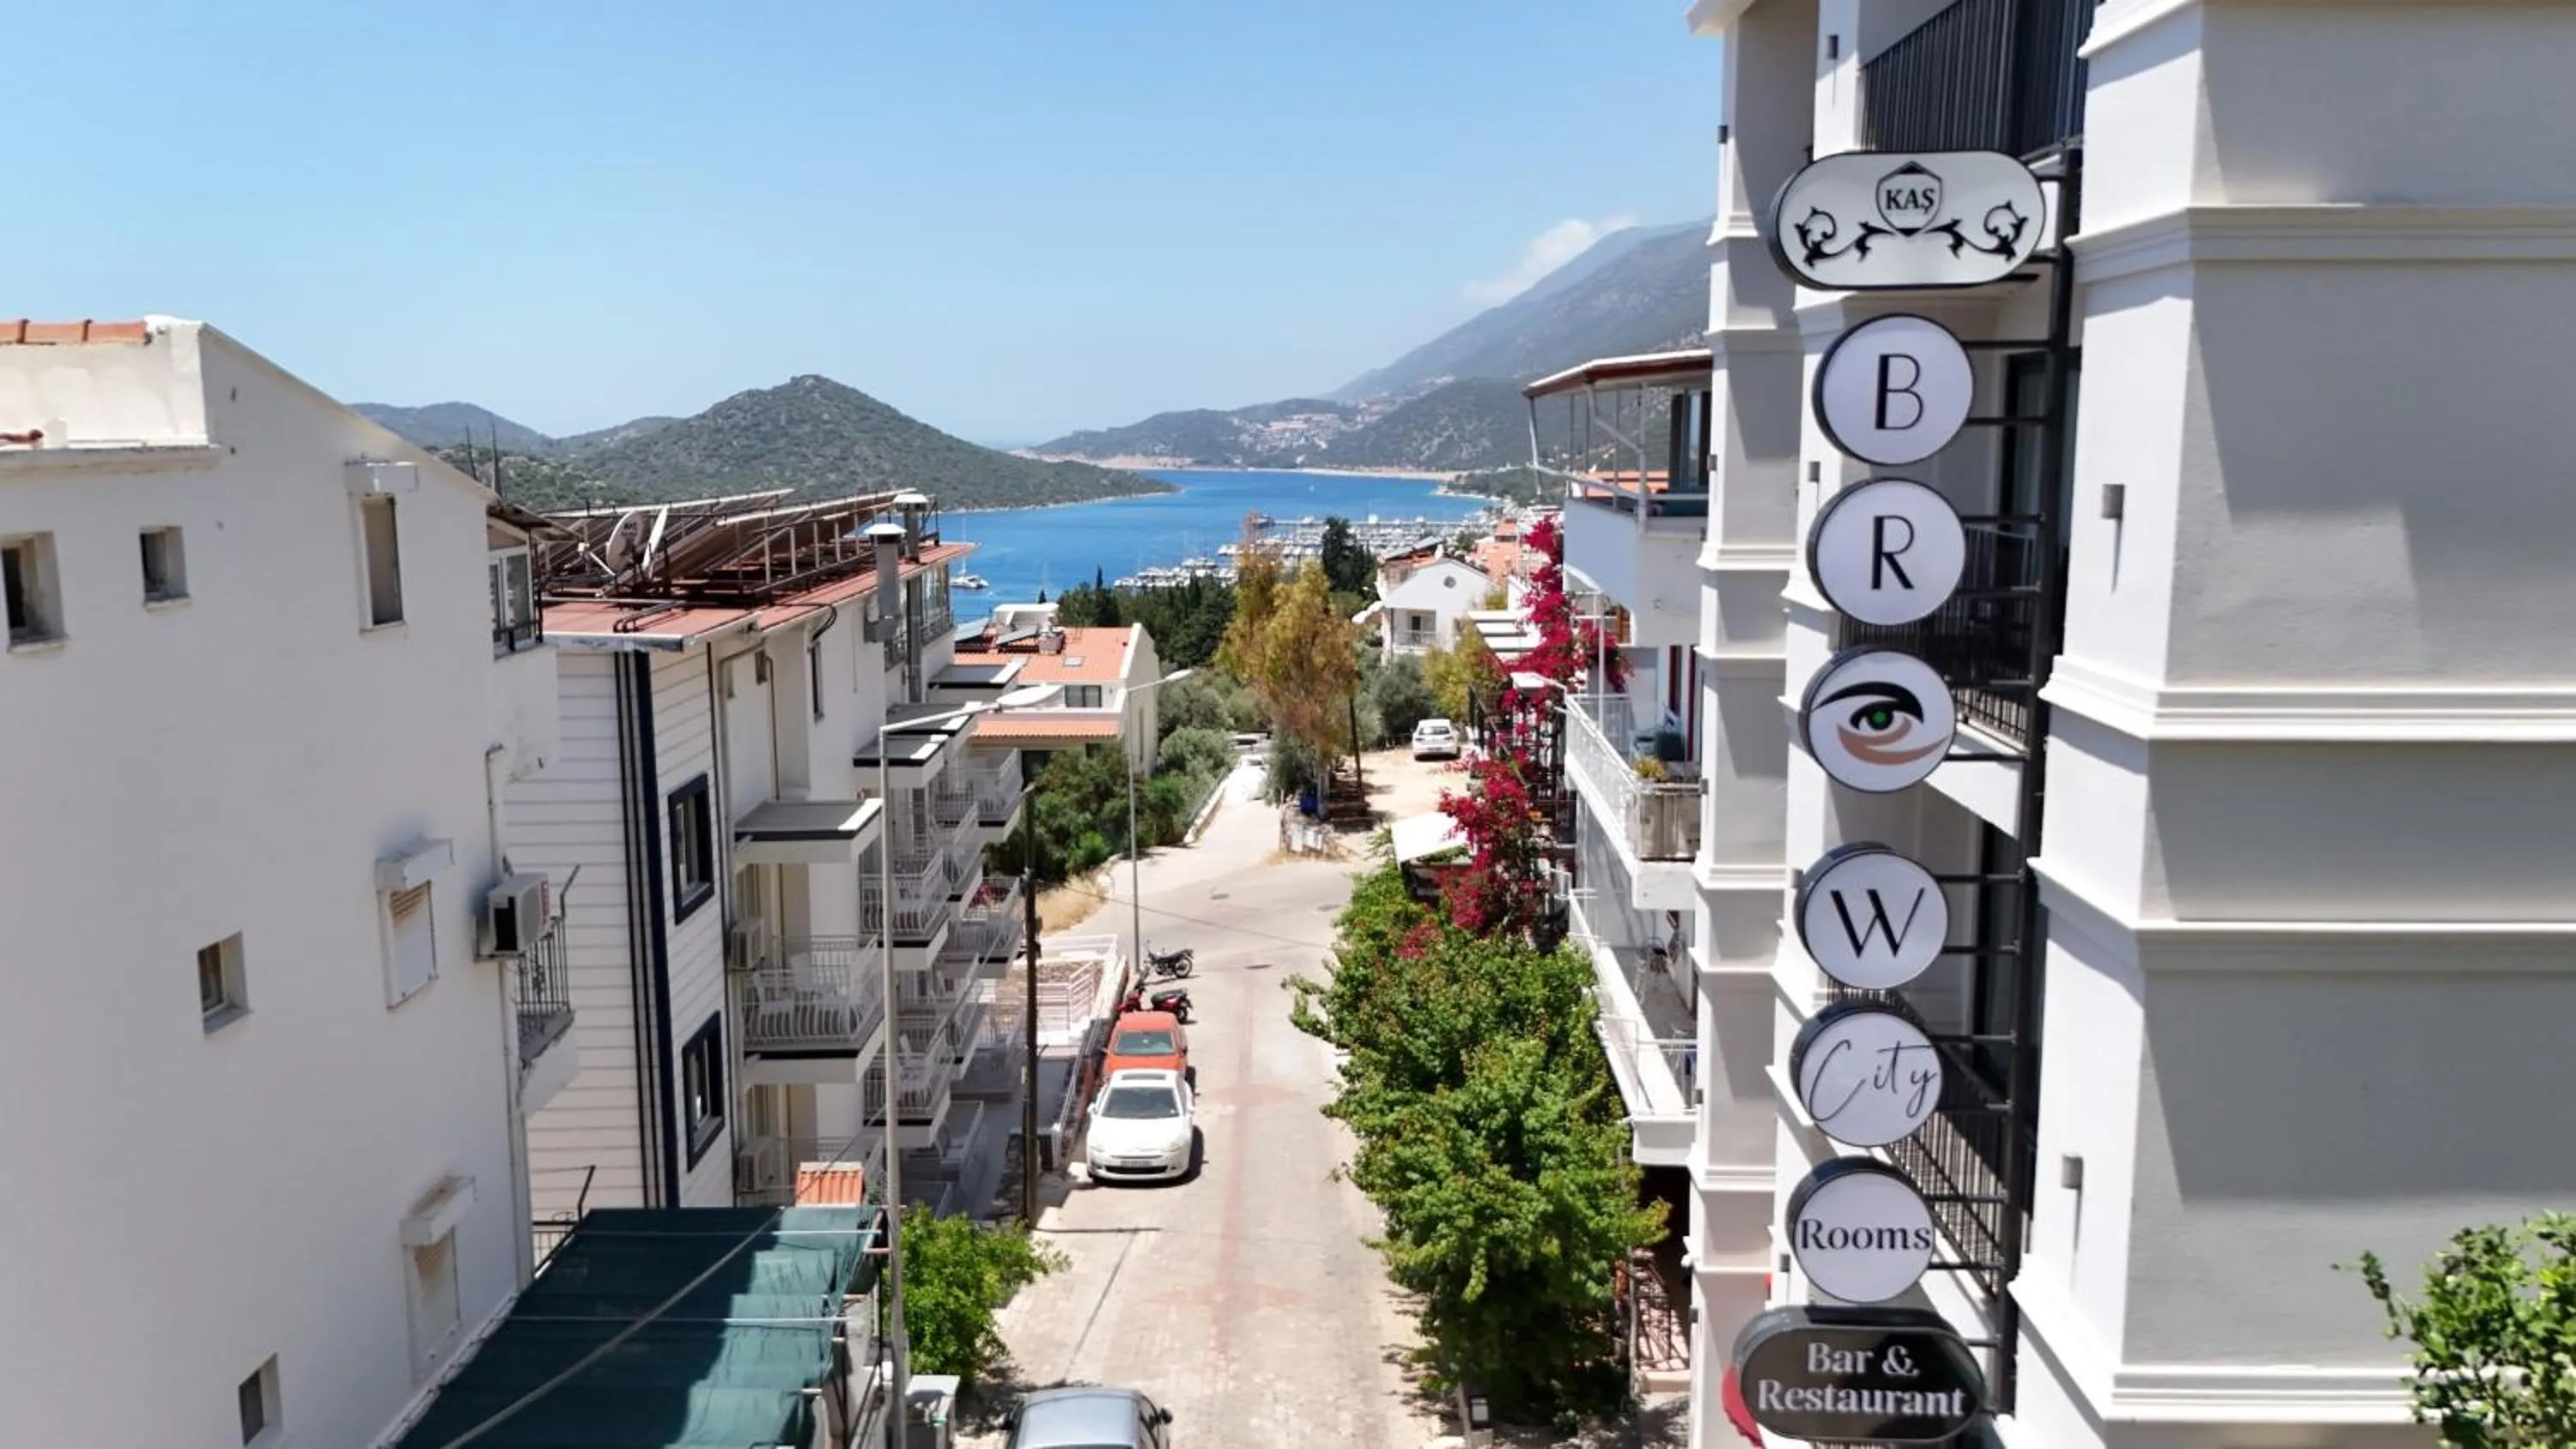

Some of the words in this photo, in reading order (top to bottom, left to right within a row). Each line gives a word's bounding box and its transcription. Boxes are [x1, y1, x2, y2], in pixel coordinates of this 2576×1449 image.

[1886, 187, 1935, 215] KAŞ
[1874, 354, 1923, 430] B
[1870, 515, 1916, 591] R
[1830, 888, 1927, 959] W
[1809, 1039, 1938, 1122] City
[1800, 1218, 1932, 1252] Rooms
[1807, 1342, 1875, 1374] Bar
[1880, 1344, 1921, 1377] &
[1757, 1378, 1965, 1416] Restaurant
